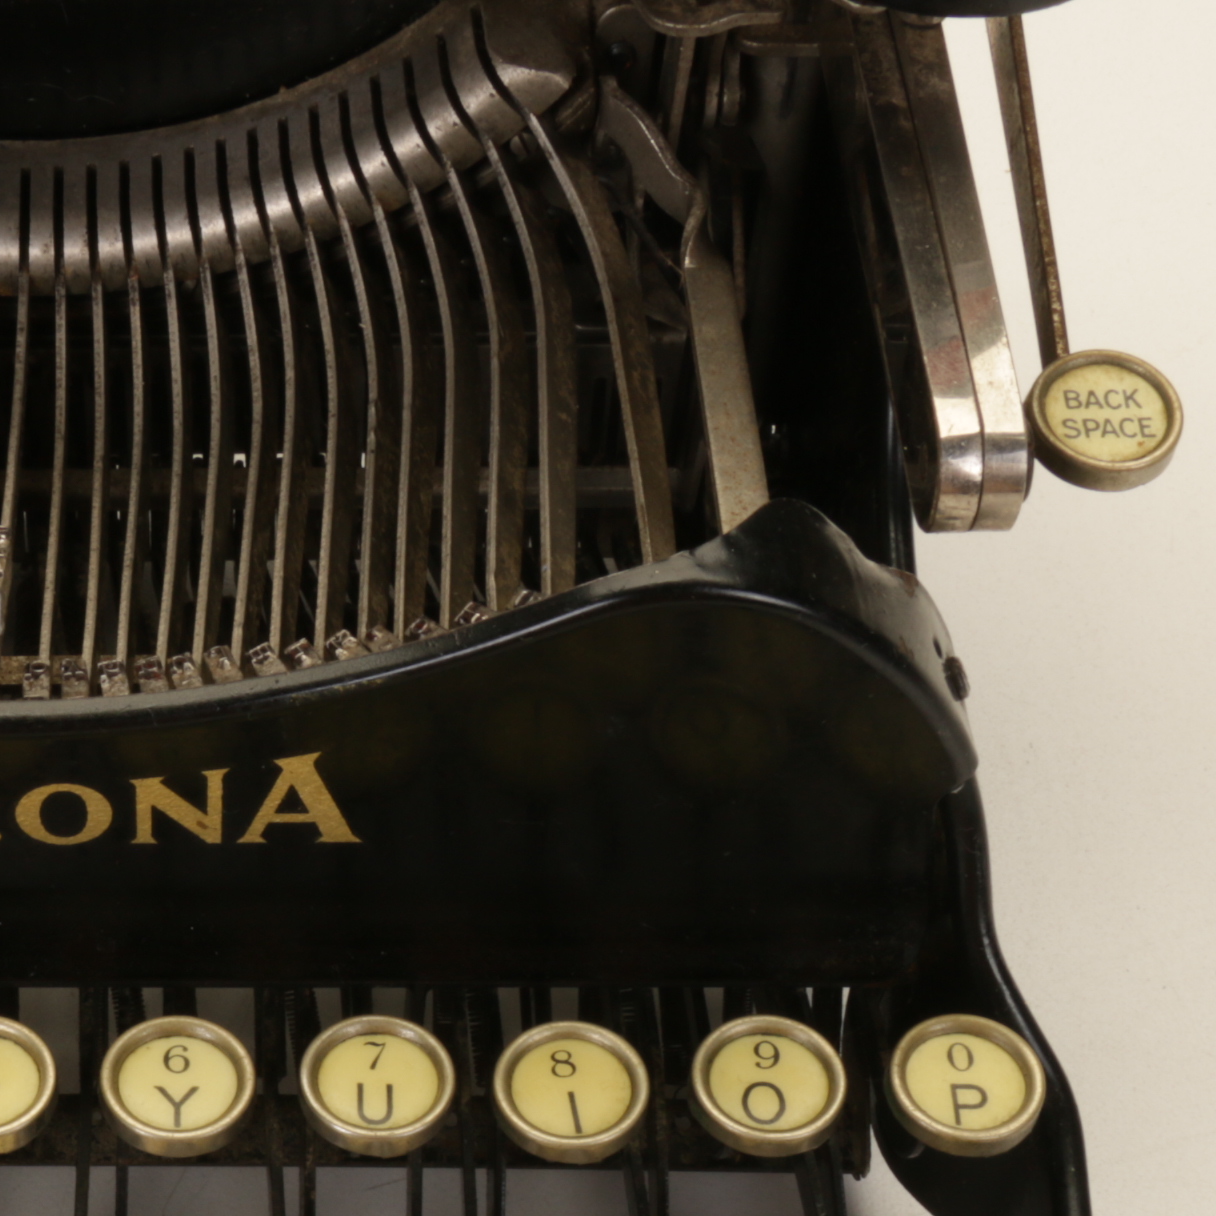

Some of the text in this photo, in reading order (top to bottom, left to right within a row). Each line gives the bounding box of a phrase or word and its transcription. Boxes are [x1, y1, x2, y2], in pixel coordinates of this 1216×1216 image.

[1062, 389, 1141, 410] BACK
[1060, 417, 1157, 440] SPACE
[163, 1045, 190, 1073] 6
[363, 1041, 386, 1070] 7
[550, 1050, 576, 1077] 8
[753, 1040, 780, 1069] 9
[947, 1043, 974, 1071] 0
[154, 1085, 200, 1128] Y
[357, 1083, 393, 1125] U
[741, 1081, 786, 1125] O
[949, 1083, 988, 1127] P
